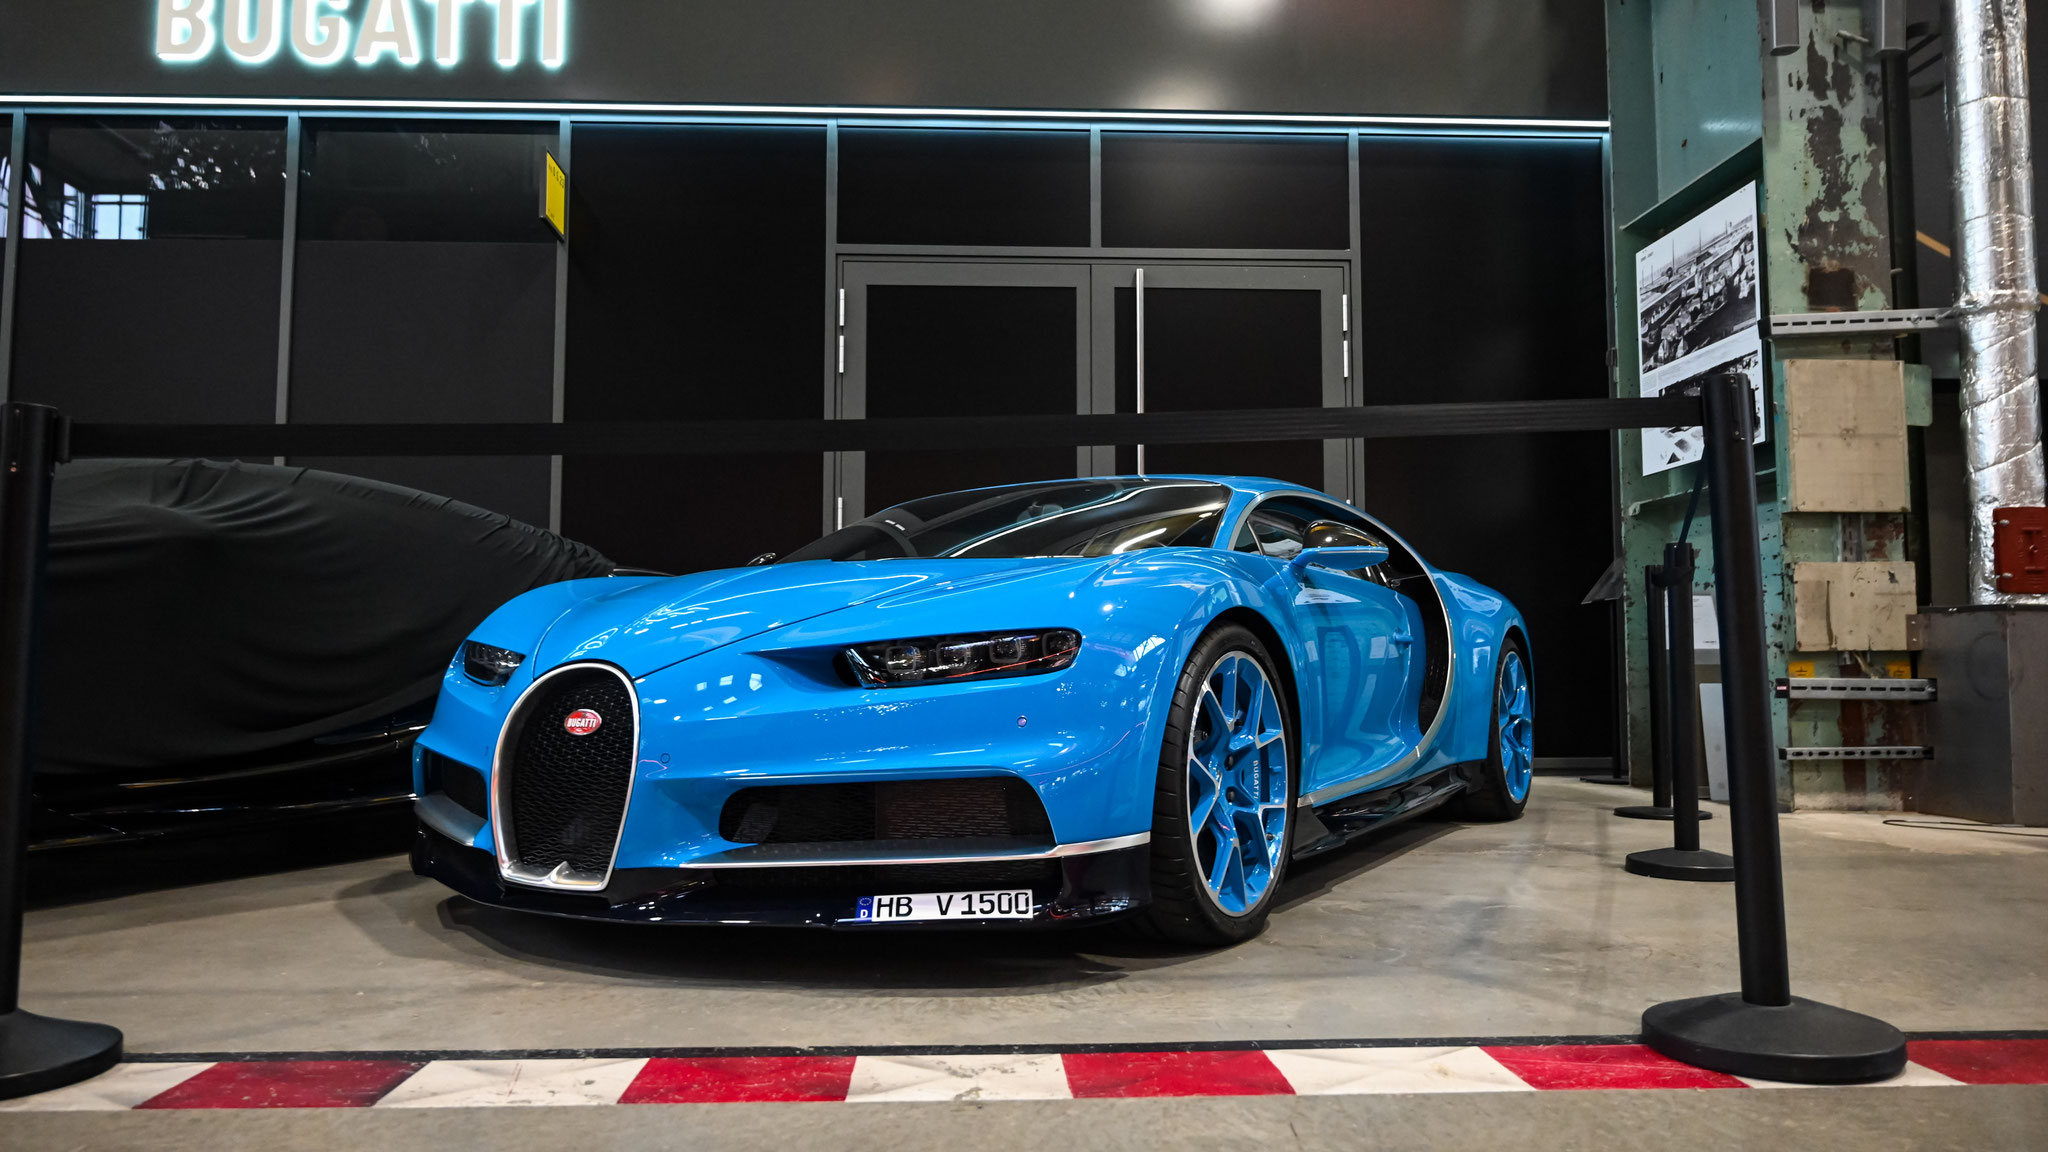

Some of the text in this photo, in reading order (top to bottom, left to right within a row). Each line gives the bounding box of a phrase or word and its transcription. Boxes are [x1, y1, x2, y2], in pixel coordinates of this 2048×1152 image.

[156, 0, 565, 67] BUGATTI
[567, 717, 597, 728] BUGATTI
[860, 909, 868, 918] D
[876, 896, 913, 918] HB
[960, 892, 1030, 915] 1500
